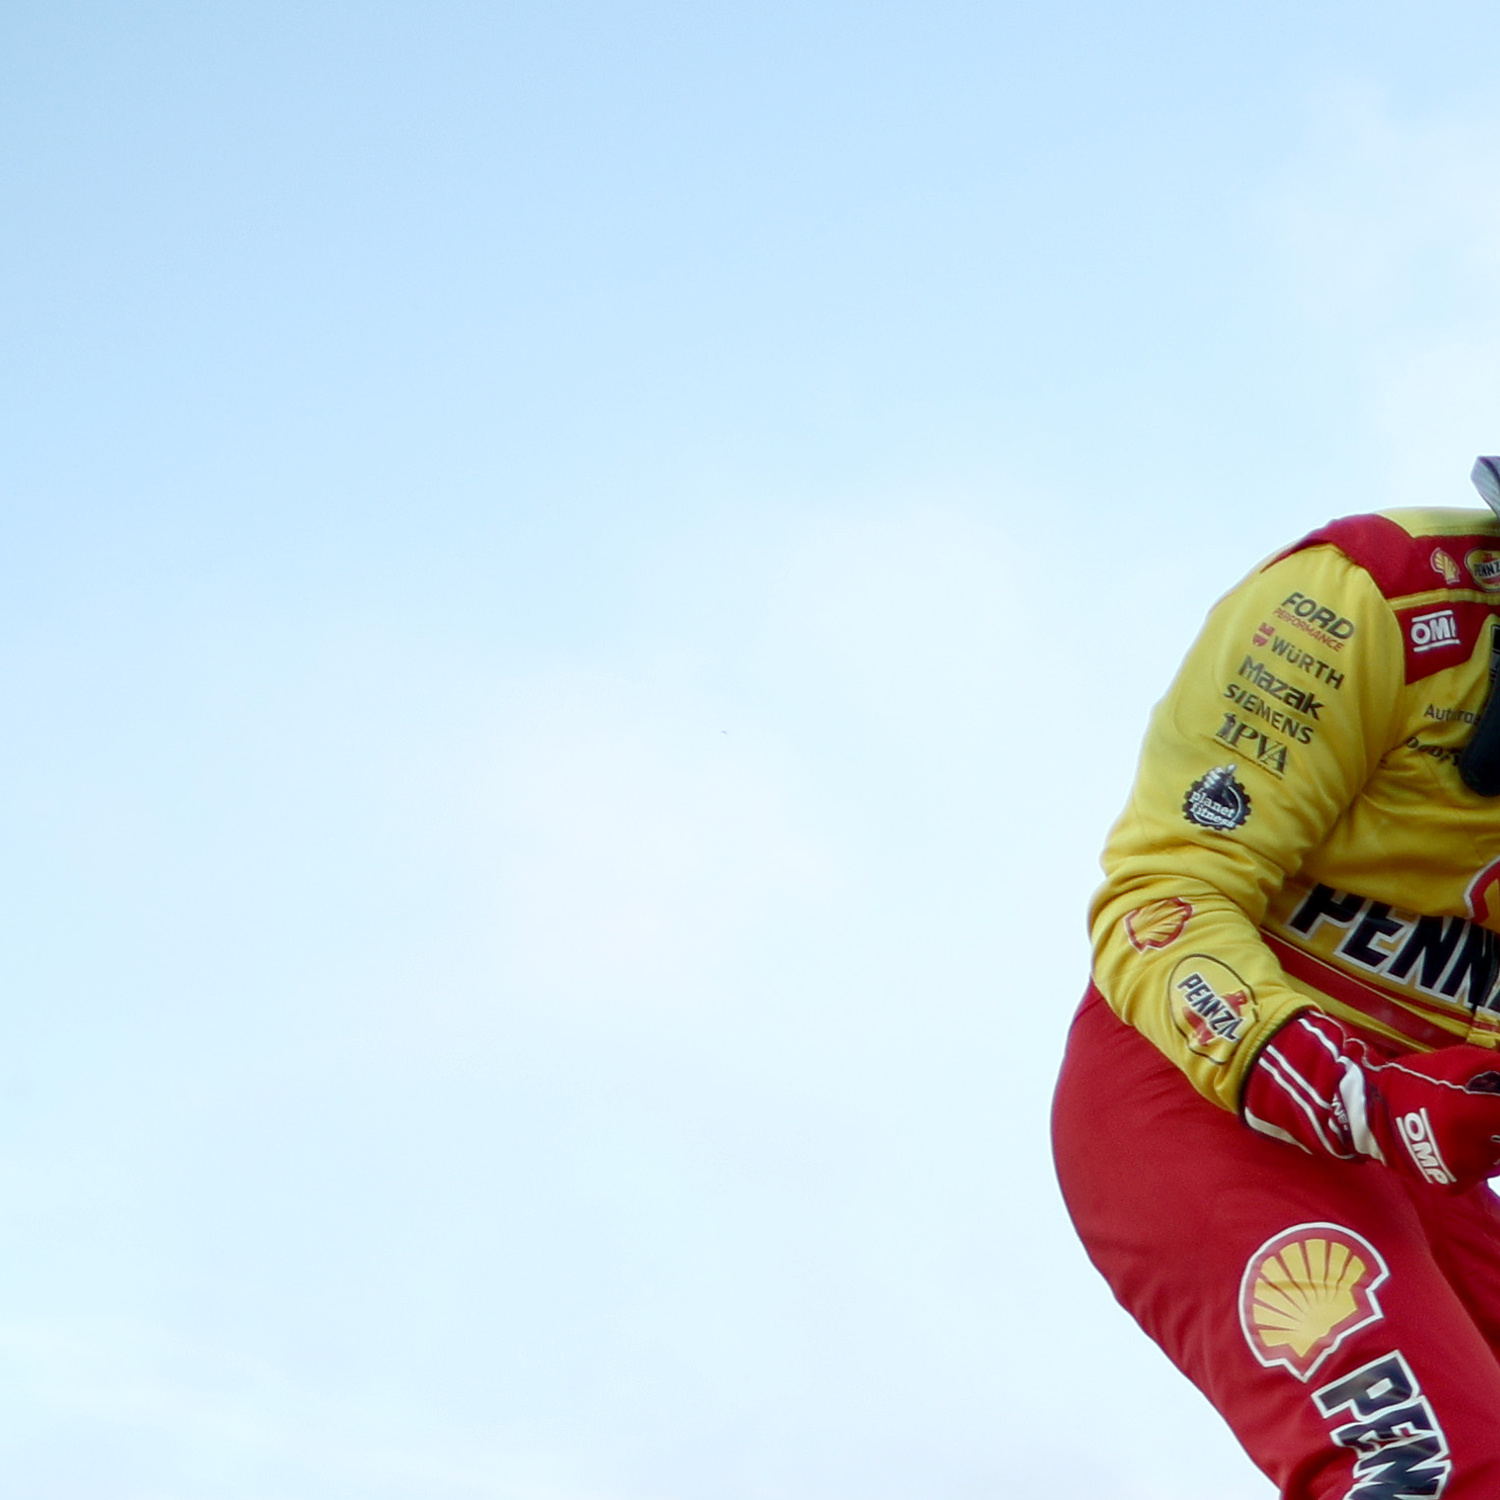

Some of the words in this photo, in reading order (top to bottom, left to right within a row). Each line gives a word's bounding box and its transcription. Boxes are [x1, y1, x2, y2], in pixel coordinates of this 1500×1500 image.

[1273, 607, 1345, 652] PERFORMANCE
[1281, 591, 1355, 640] FORD
[1238, 655, 1325, 721] Mazak
[1223, 683, 1315, 745] SIEMENS
[1189, 791, 1236, 818] planet
[1190, 803, 1236, 828] fitness
[1402, 1112, 1452, 1186] OMP
